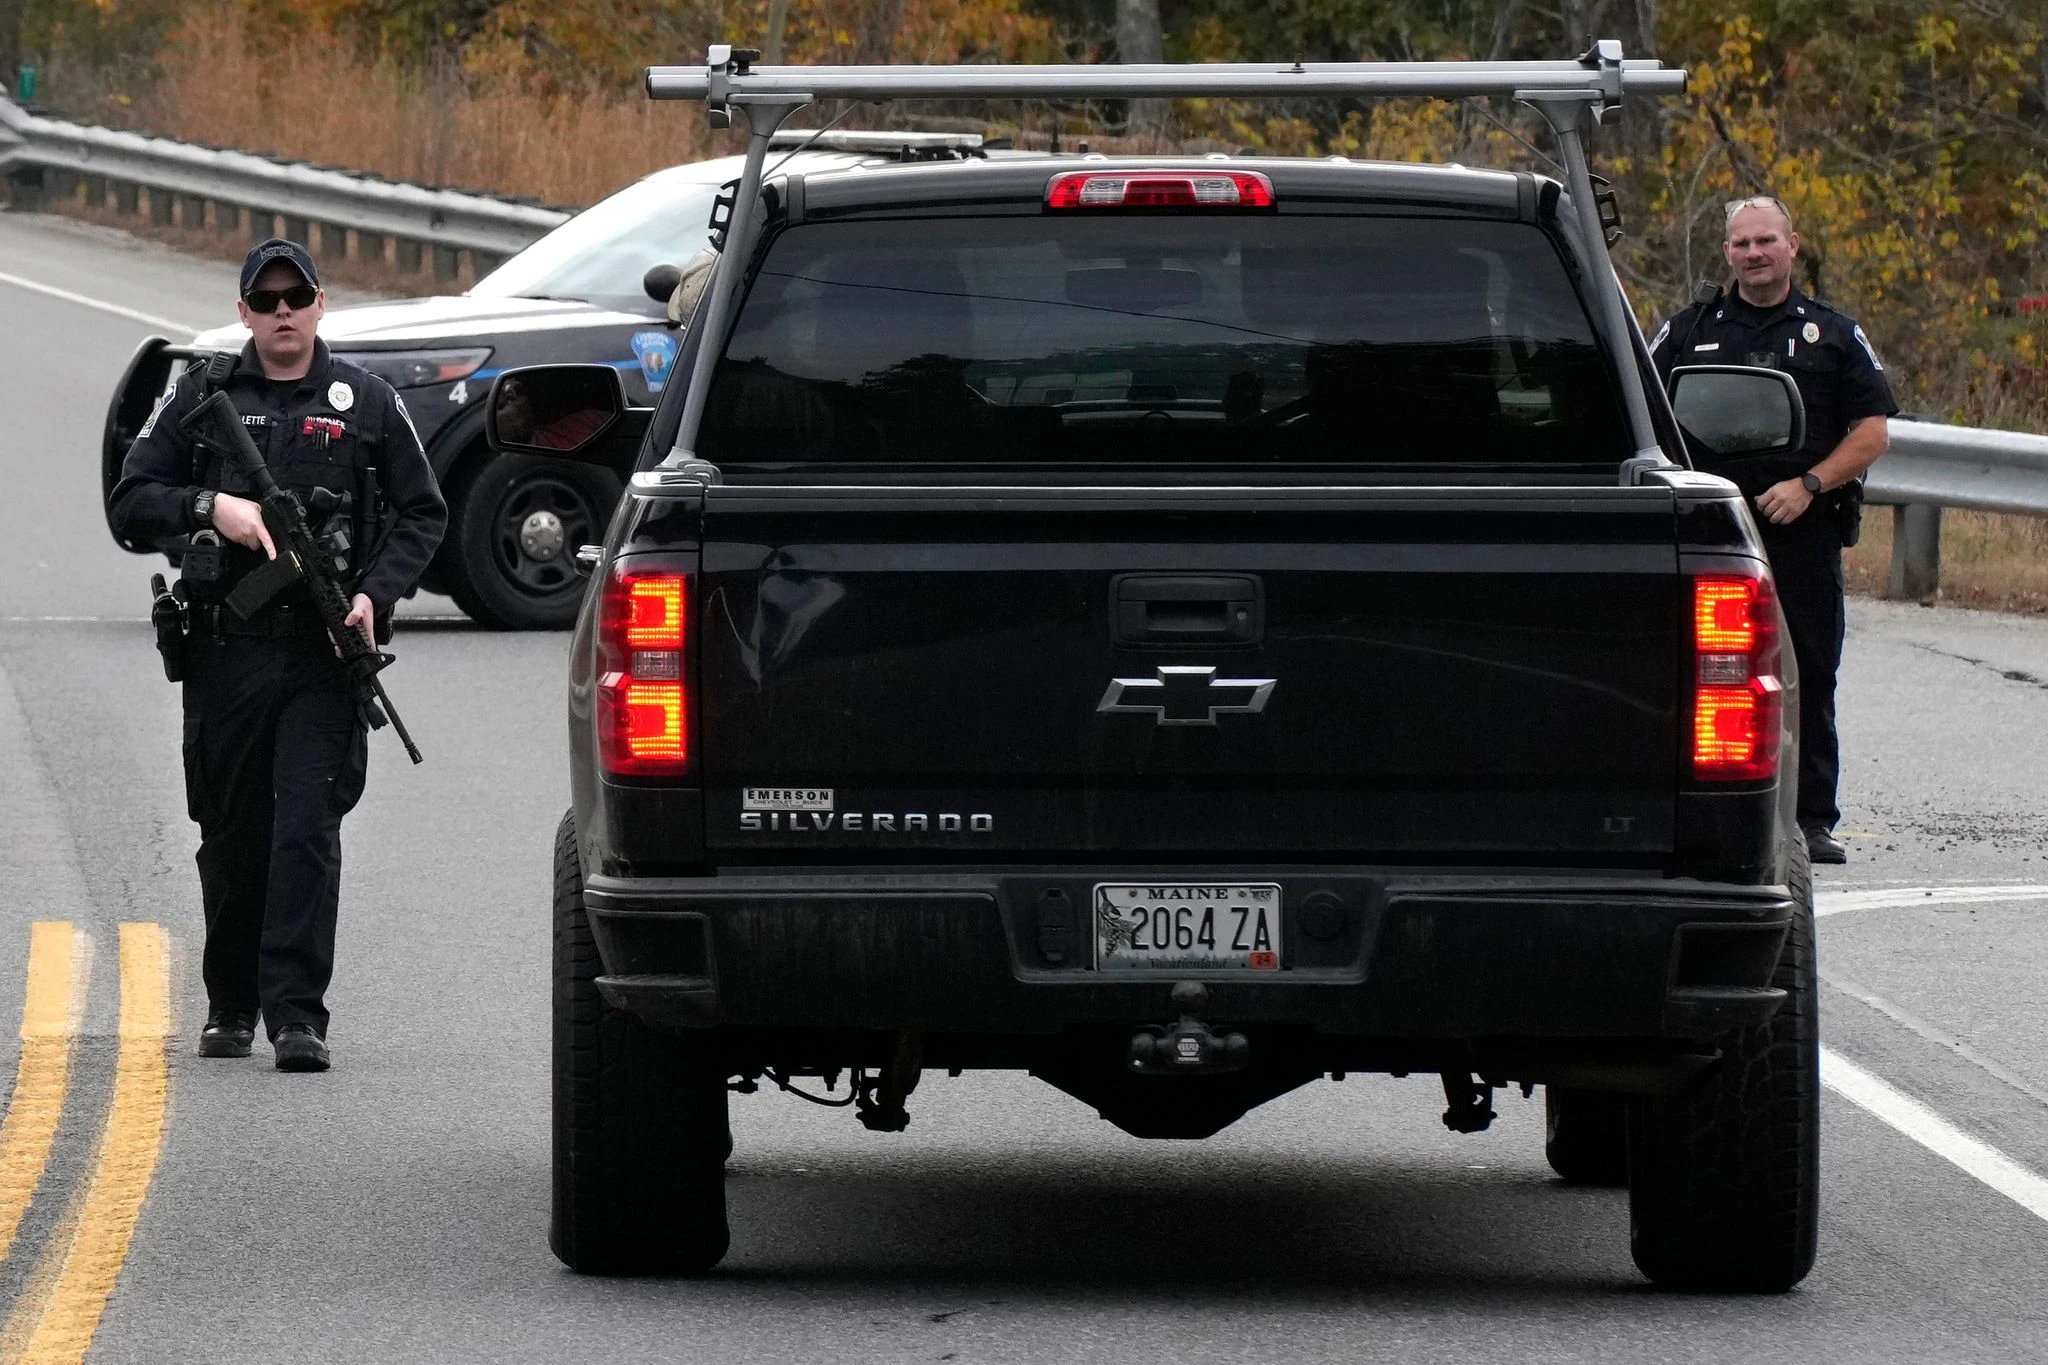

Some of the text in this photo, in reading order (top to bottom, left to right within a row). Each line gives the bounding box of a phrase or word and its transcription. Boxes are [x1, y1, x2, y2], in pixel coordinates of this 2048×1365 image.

[260, 249, 296, 260] POLICE
[448, 380, 468, 405] 4
[747, 790, 829, 801] EMERSON
[740, 812, 993, 833] SILVERADO
[1603, 816, 1634, 833] LT
[1147, 888, 1229, 900] MAINE
[1130, 906, 1272, 951] 2064 ZA
[1255, 955, 1271, 967] 24
